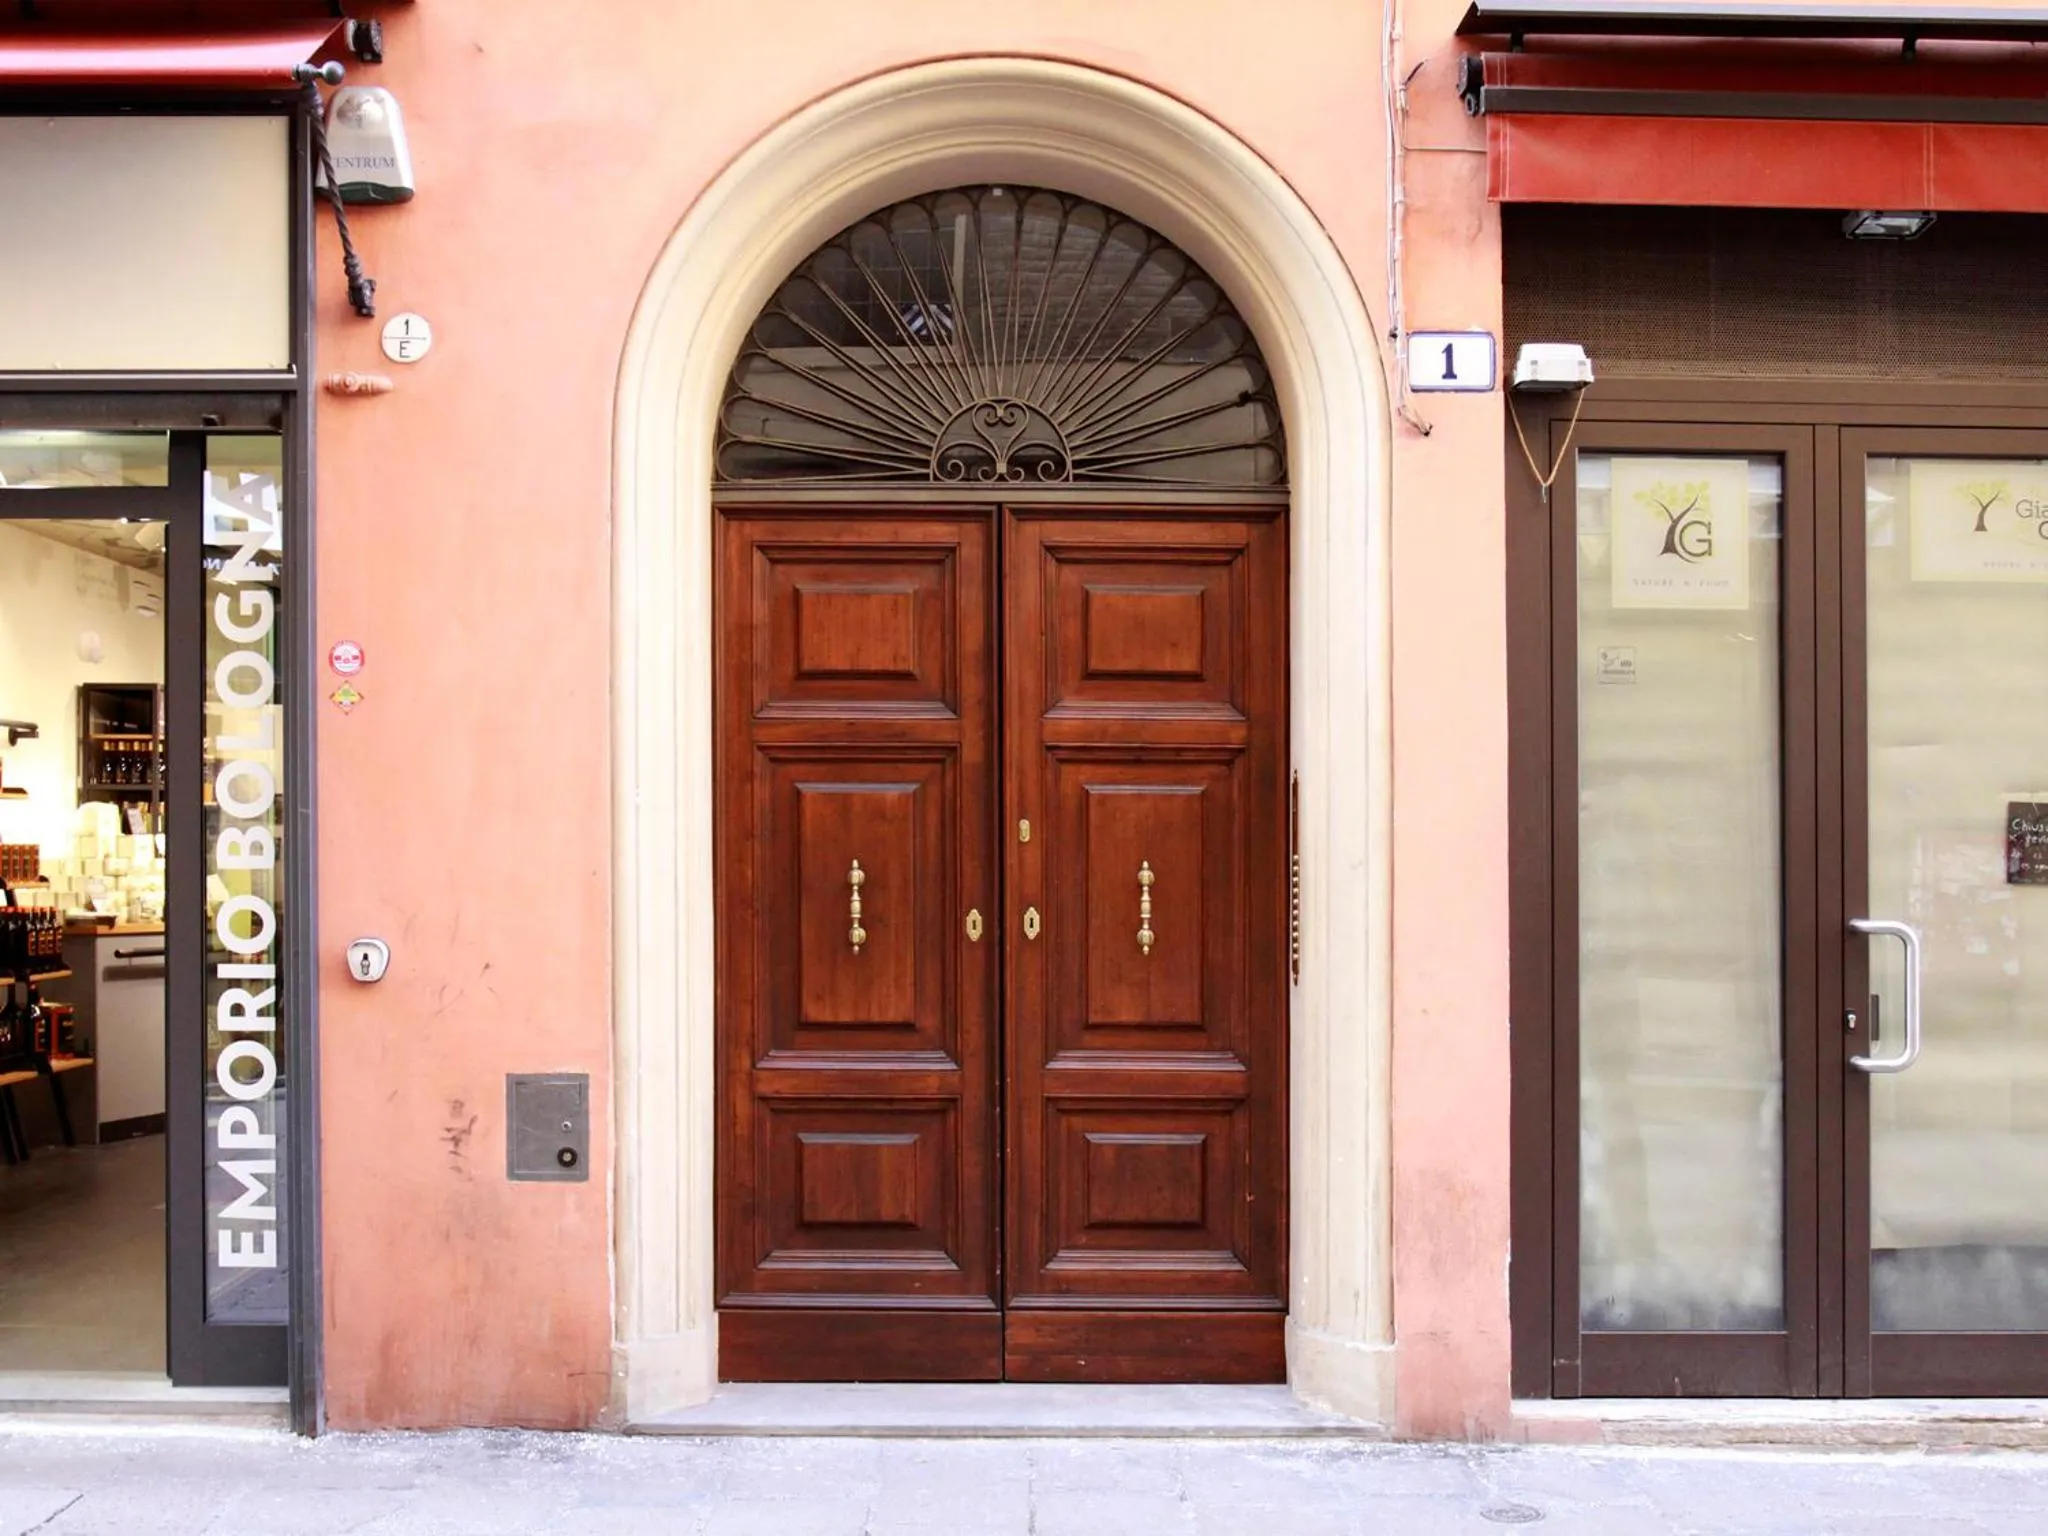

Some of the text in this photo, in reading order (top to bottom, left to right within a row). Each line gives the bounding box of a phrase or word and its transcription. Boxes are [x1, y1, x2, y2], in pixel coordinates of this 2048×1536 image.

[330, 157, 395, 169] ENTRUM
[404, 318, 410, 336] 1
[399, 340, 411, 358] E
[1441, 343, 1458, 379] 1
[213, 471, 276, 870] BOLOGNA
[216, 893, 277, 1268] EMPORIO
